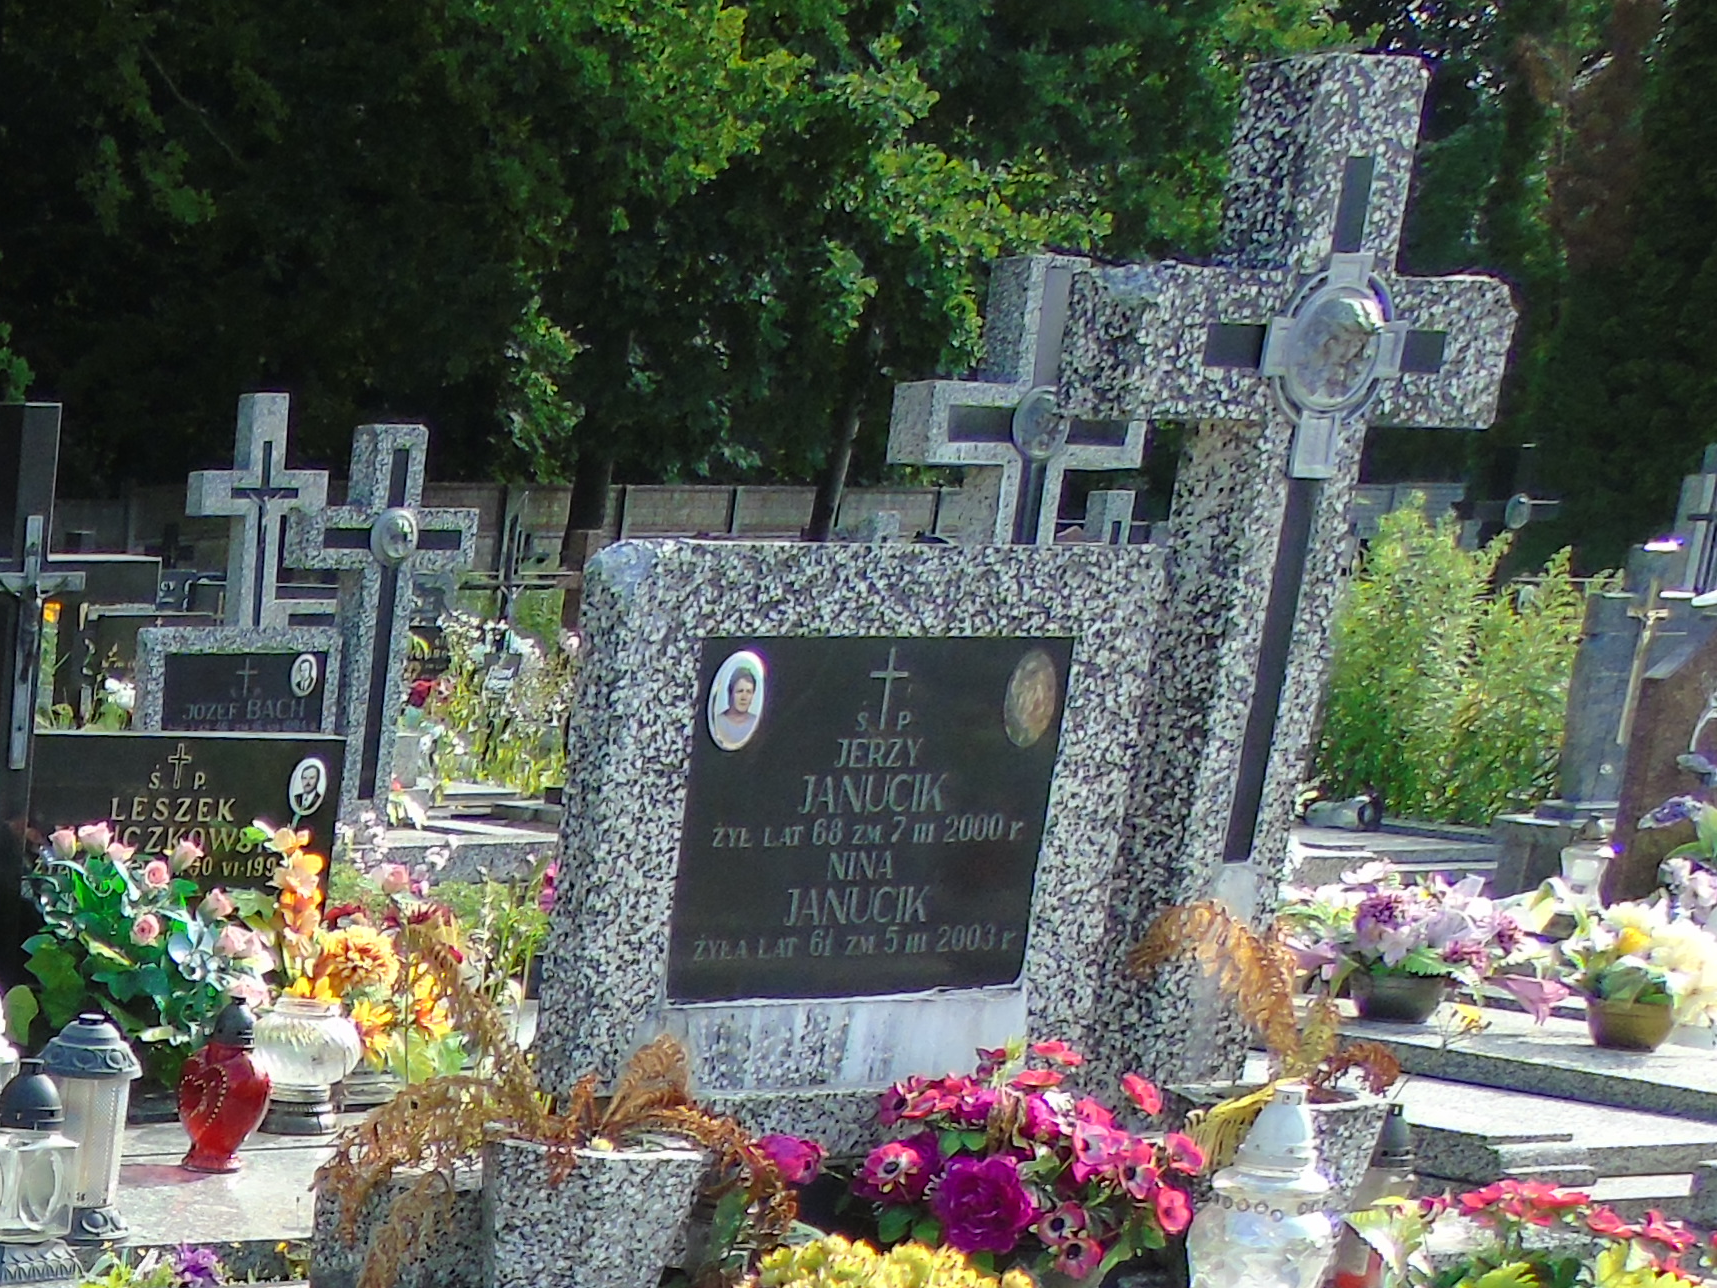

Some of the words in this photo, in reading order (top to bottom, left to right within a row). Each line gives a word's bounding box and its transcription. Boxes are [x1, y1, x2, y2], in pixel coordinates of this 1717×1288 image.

[247, 698, 306, 720] BACH
[897, 711, 912, 732] P
[833, 737, 924, 769] JERZY
[110, 796, 237, 823] LESZEK
[797, 773, 948, 815] JANUCIK
[711, 822, 754, 848] ŻYŁ
[763, 825, 804, 848] LAT
[811, 818, 843, 846] 68
[890, 816, 907, 844] 7
[942, 813, 1004, 843] 2000
[827, 850, 894, 882] NINA
[783, 885, 931, 927] JANUCIK
[757, 937, 799, 960] LAT
[808, 929, 833, 957] 61
[883, 926, 902, 954] 5
[936, 923, 995, 952] 2003
